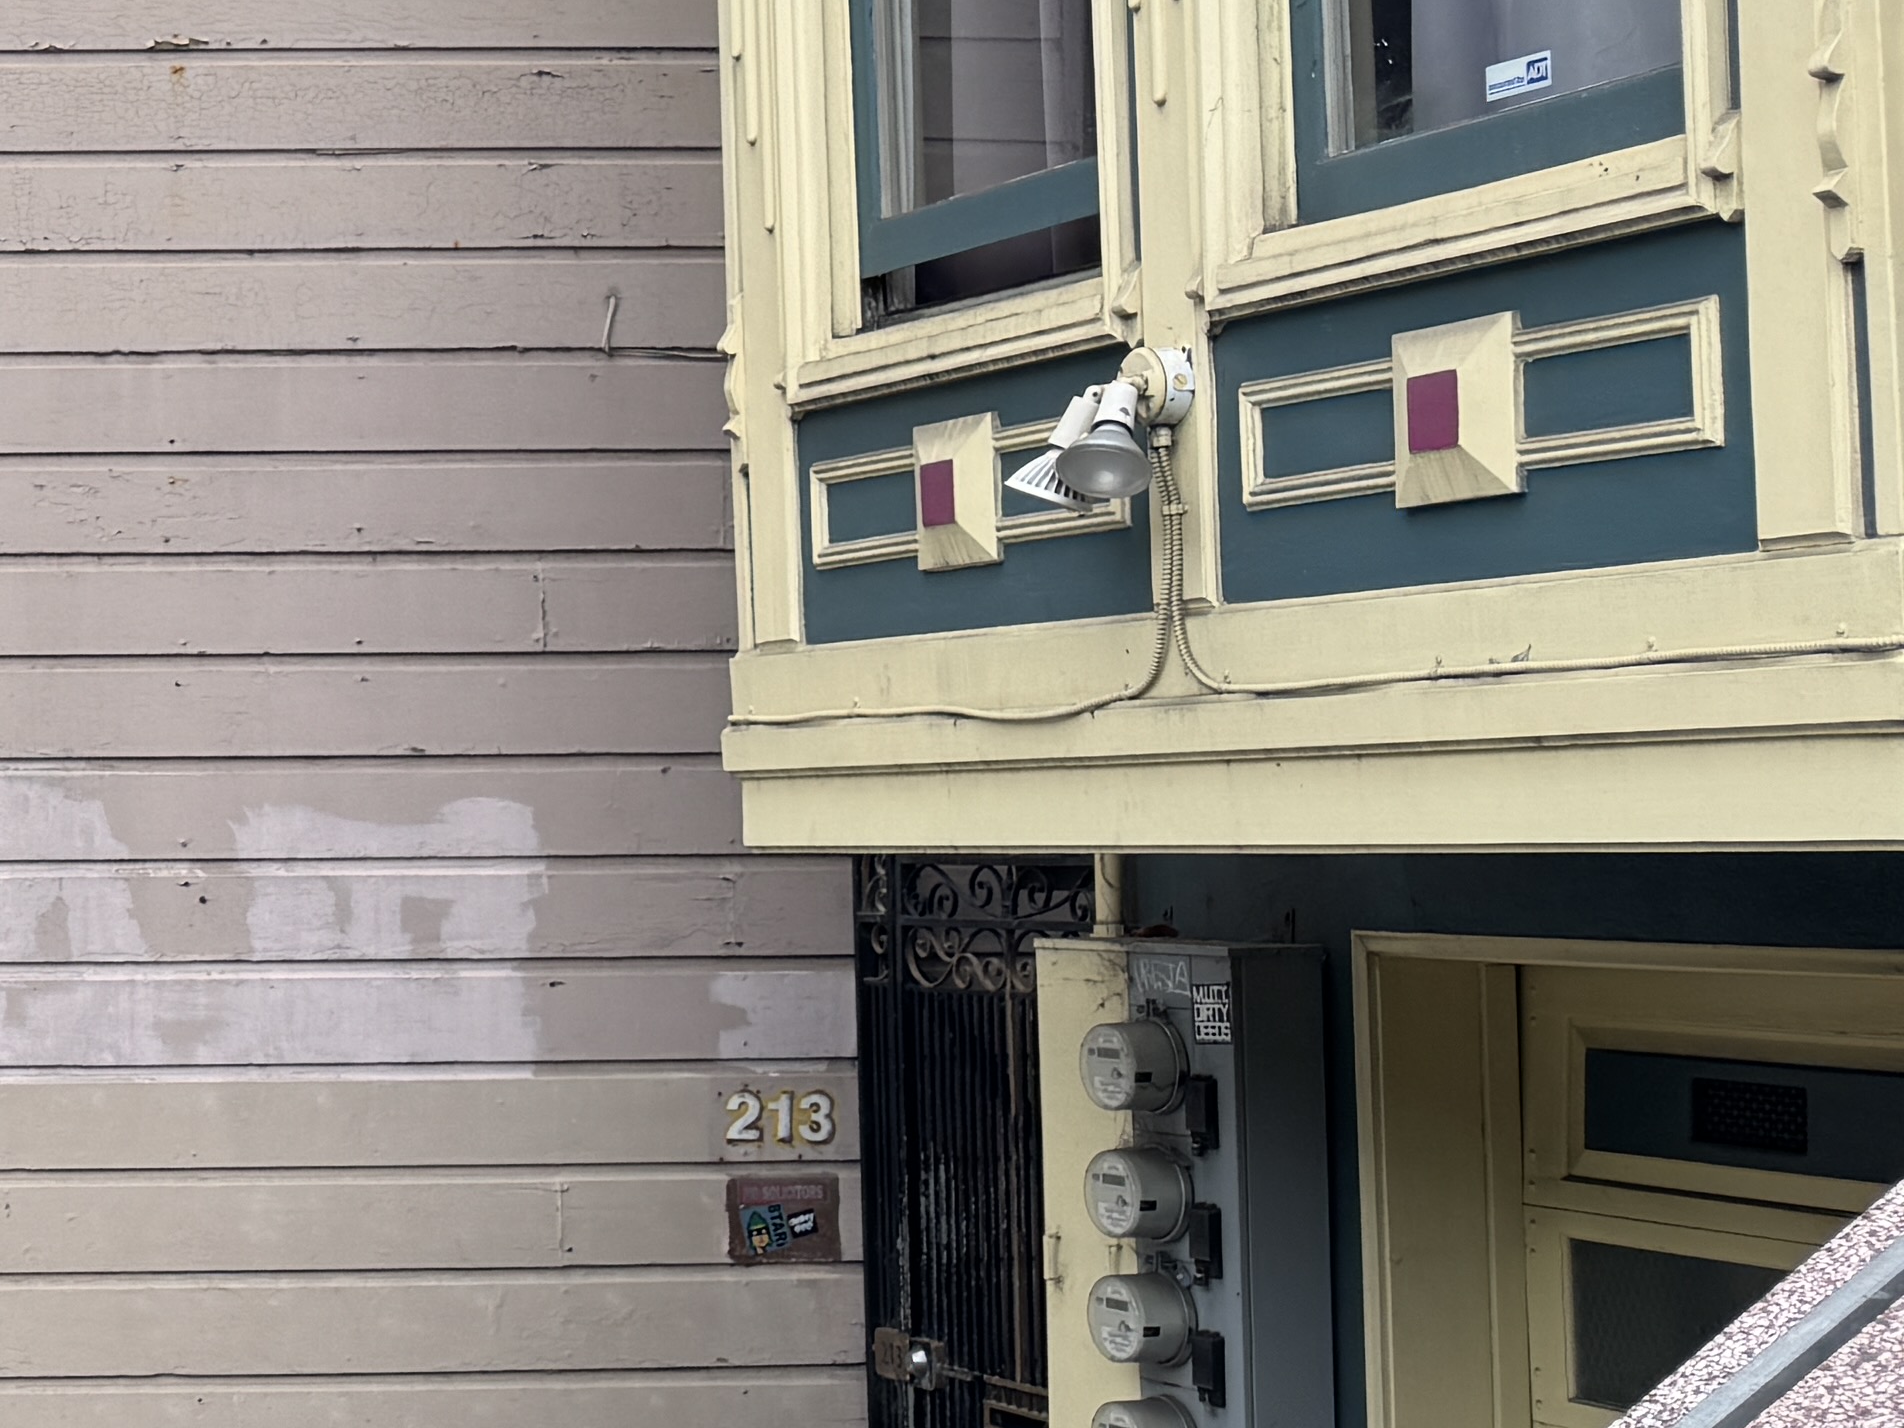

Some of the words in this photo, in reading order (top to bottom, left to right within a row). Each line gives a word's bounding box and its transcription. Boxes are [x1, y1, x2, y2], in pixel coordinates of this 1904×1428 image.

[1528, 60, 1548, 79] ADT
[1194, 1003, 1229, 1022] DIRTY
[726, 1090, 835, 1144] 213
[762, 1184, 824, 1200] SOLICITORS
